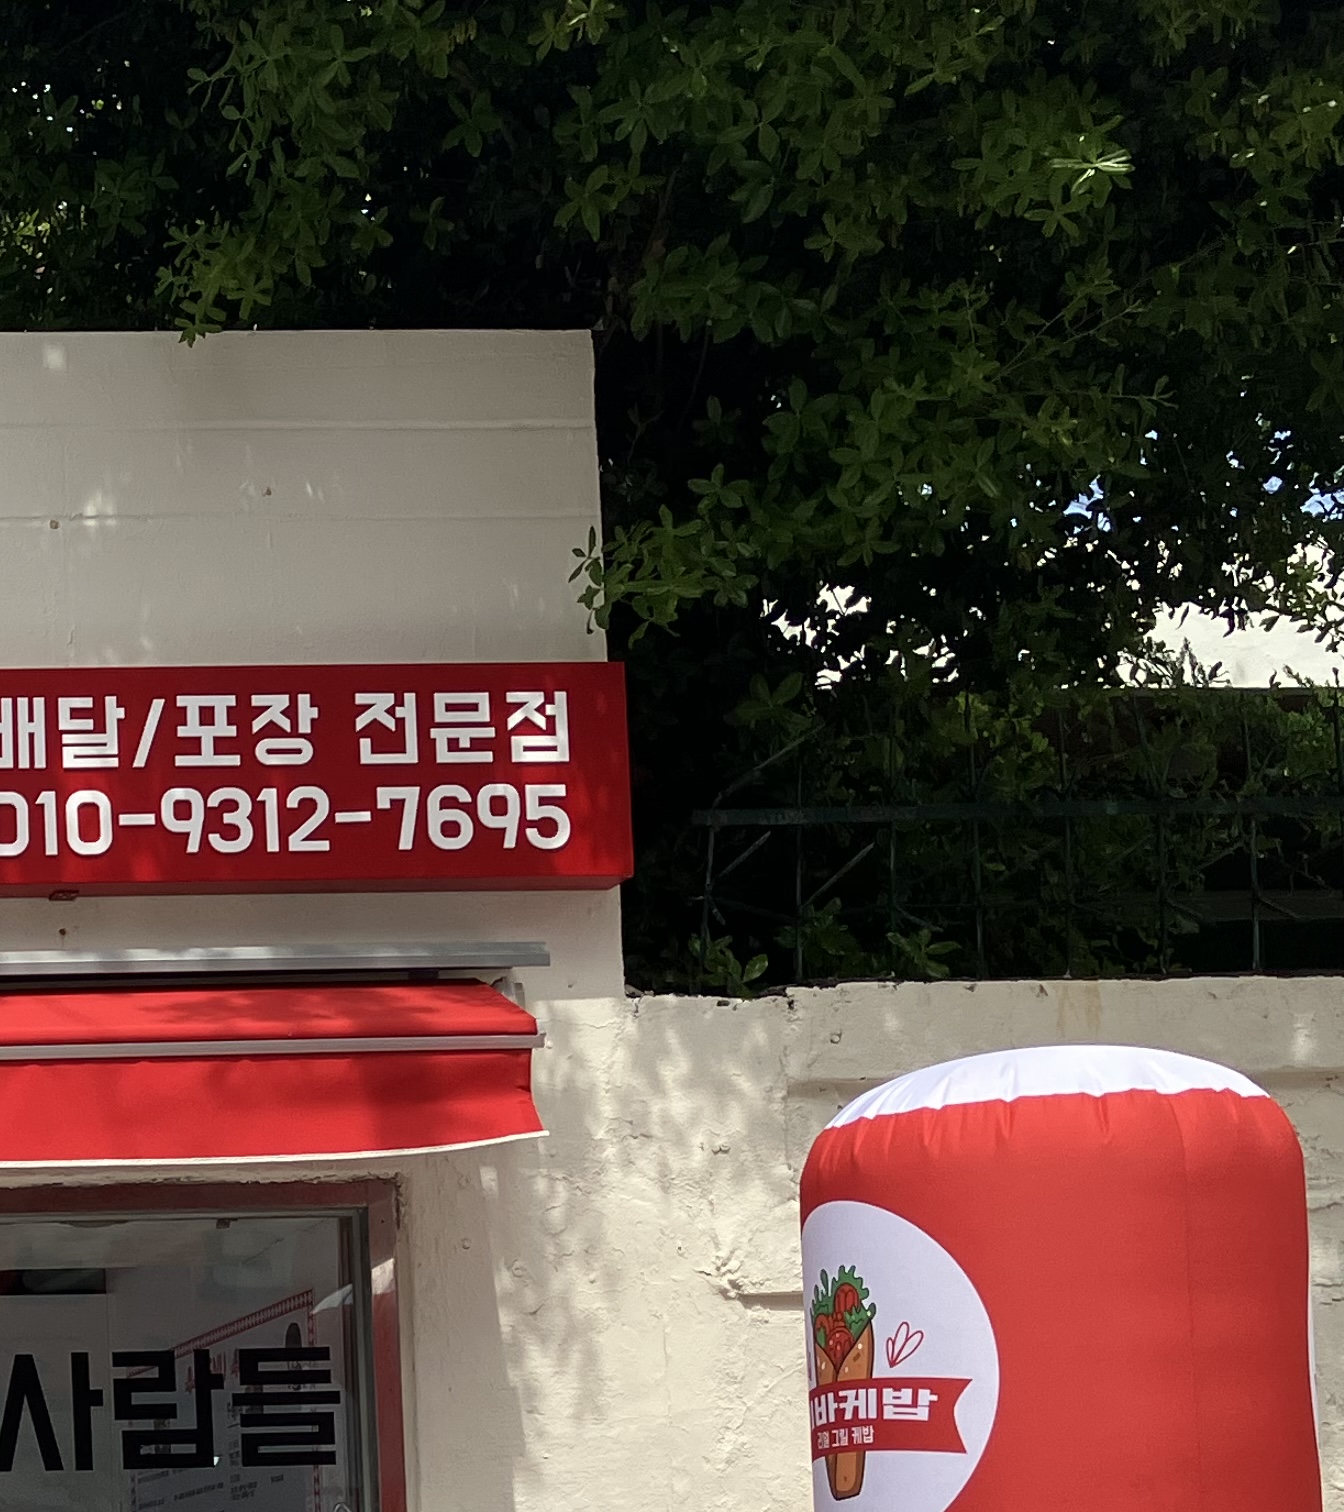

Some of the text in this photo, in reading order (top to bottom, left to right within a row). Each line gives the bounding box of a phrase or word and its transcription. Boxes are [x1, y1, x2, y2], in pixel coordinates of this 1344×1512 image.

[354, 690, 571, 764] 전문점
[811, 1388, 938, 1429] 바케밥
[852, 1425, 874, 1444] 케밥
